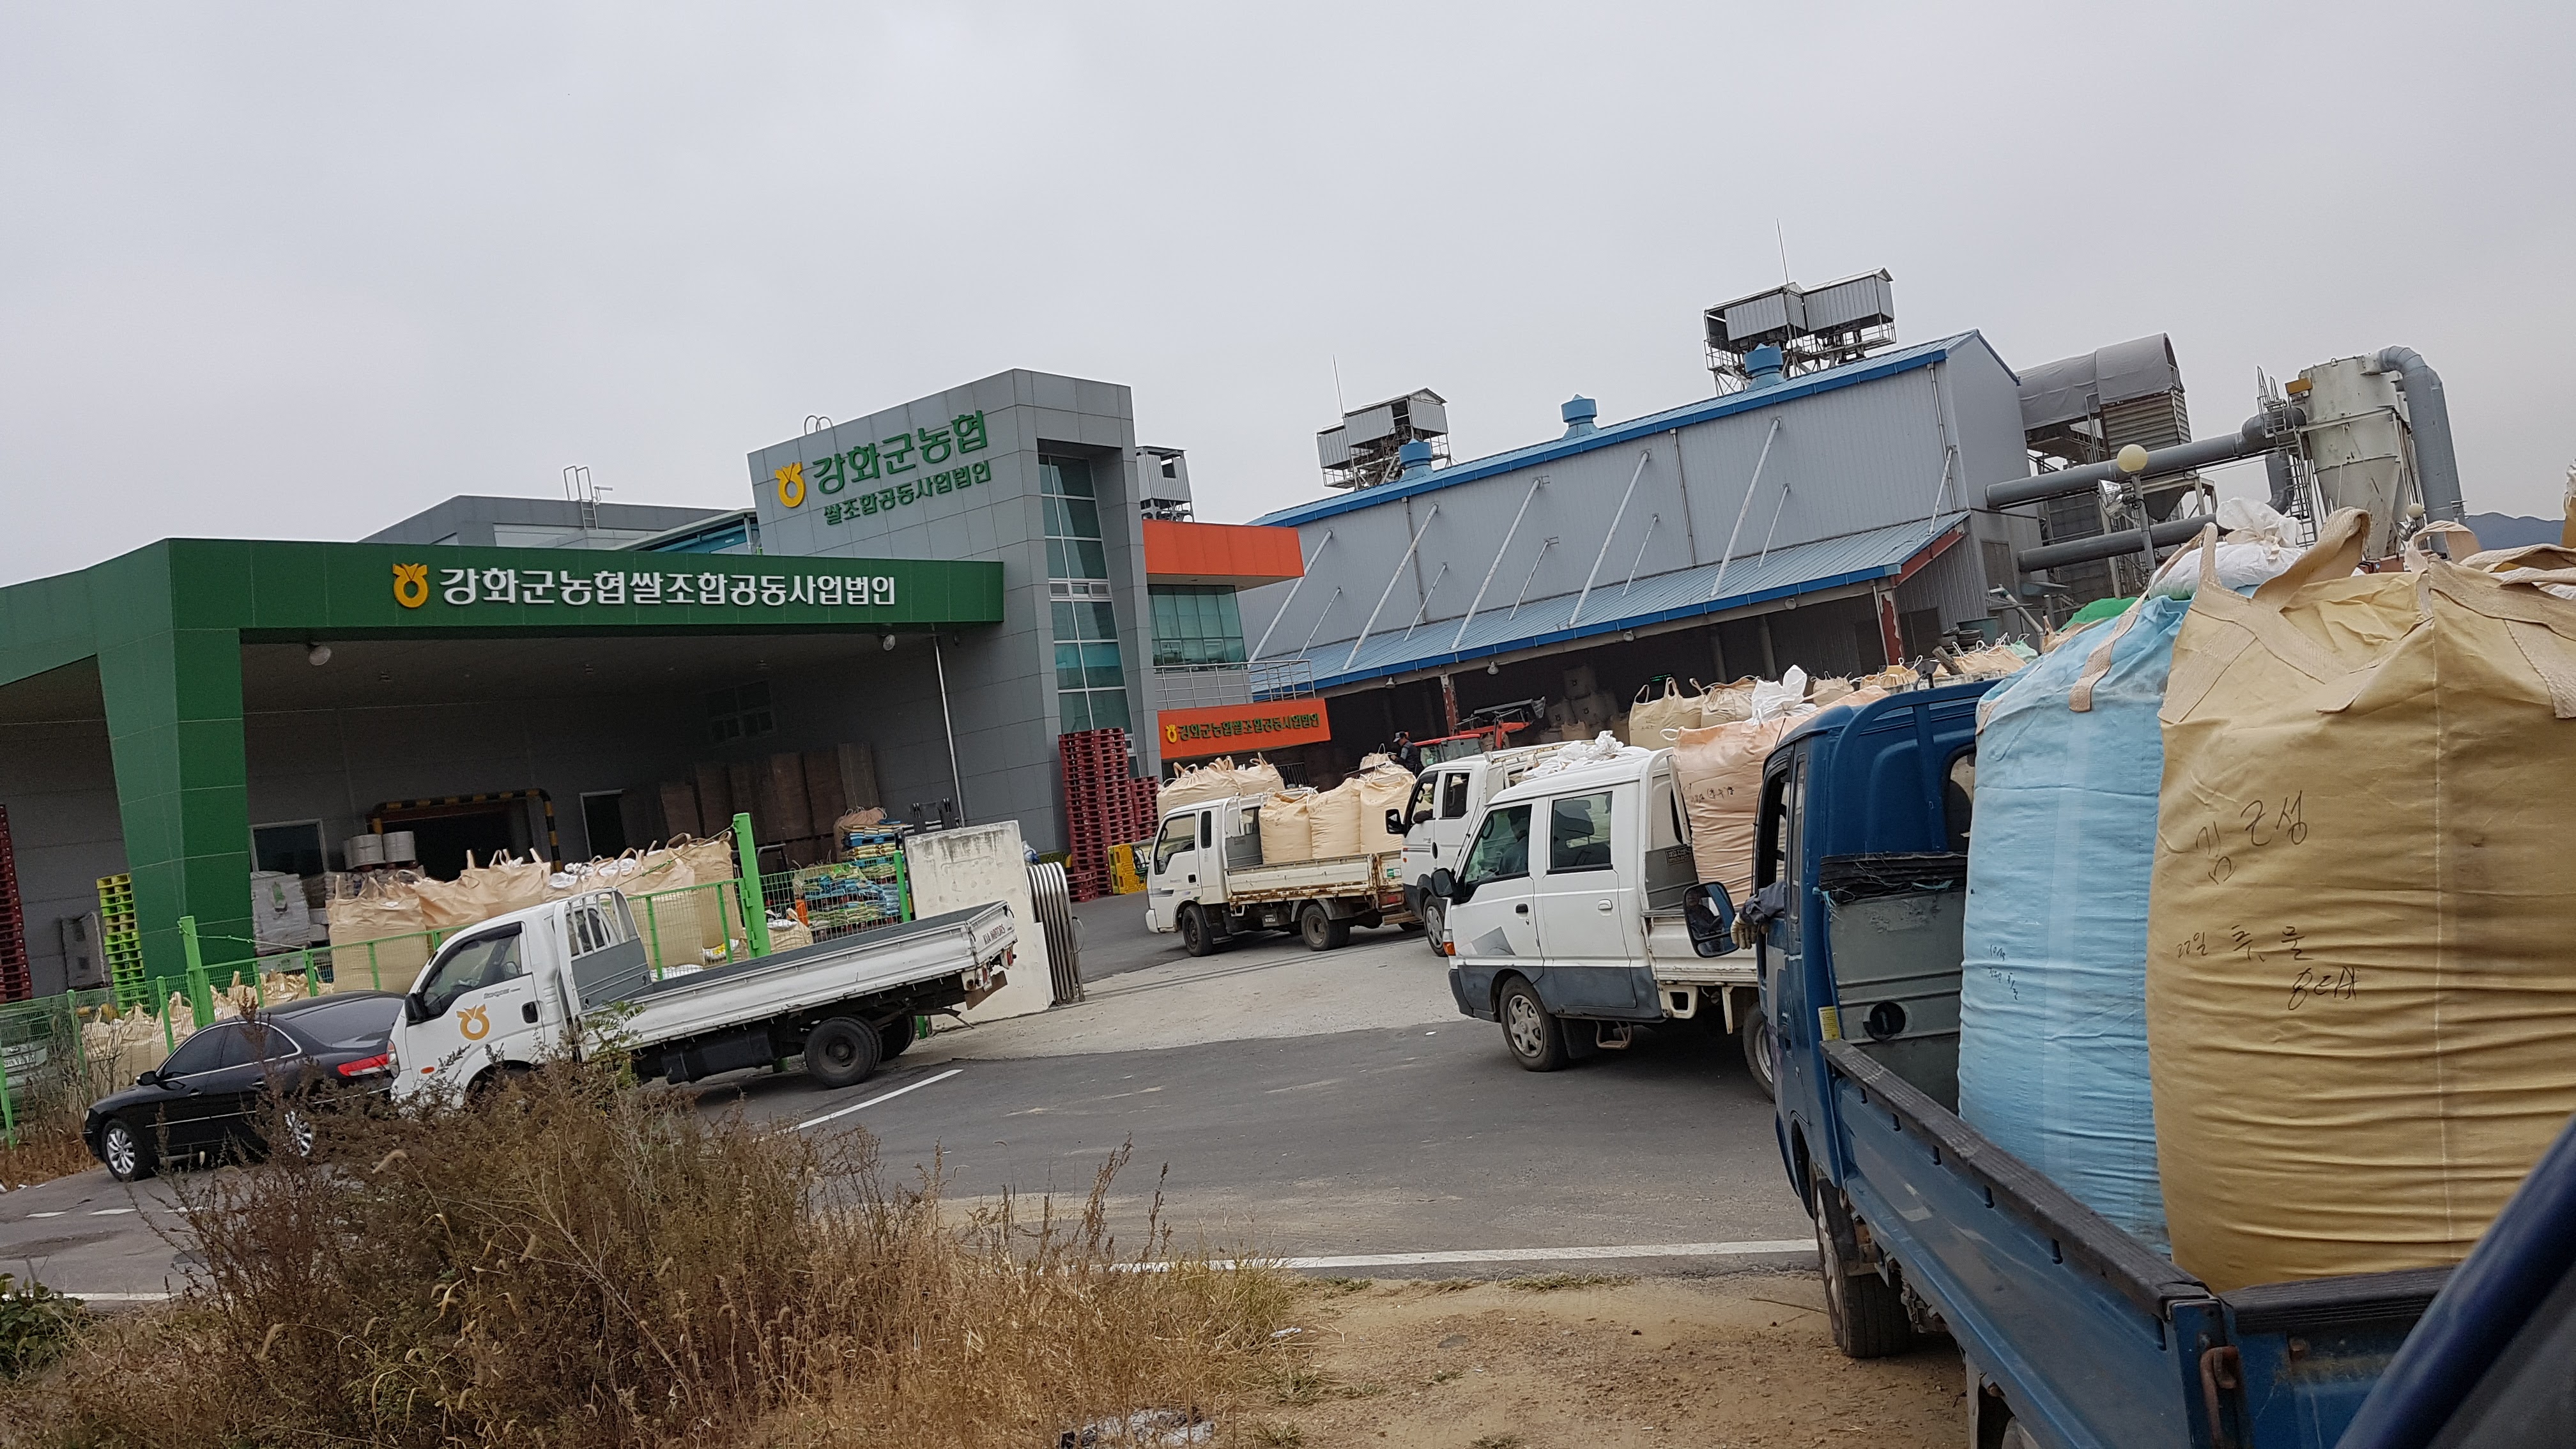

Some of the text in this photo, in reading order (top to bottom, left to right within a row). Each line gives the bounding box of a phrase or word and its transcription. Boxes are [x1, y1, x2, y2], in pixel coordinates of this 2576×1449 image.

[812, 410, 988, 494] 강화군농협
[824, 460, 992, 525] 쌀조합공동사업법인
[439, 567, 896, 606] 강화군농협쌀조합공동사업법인
